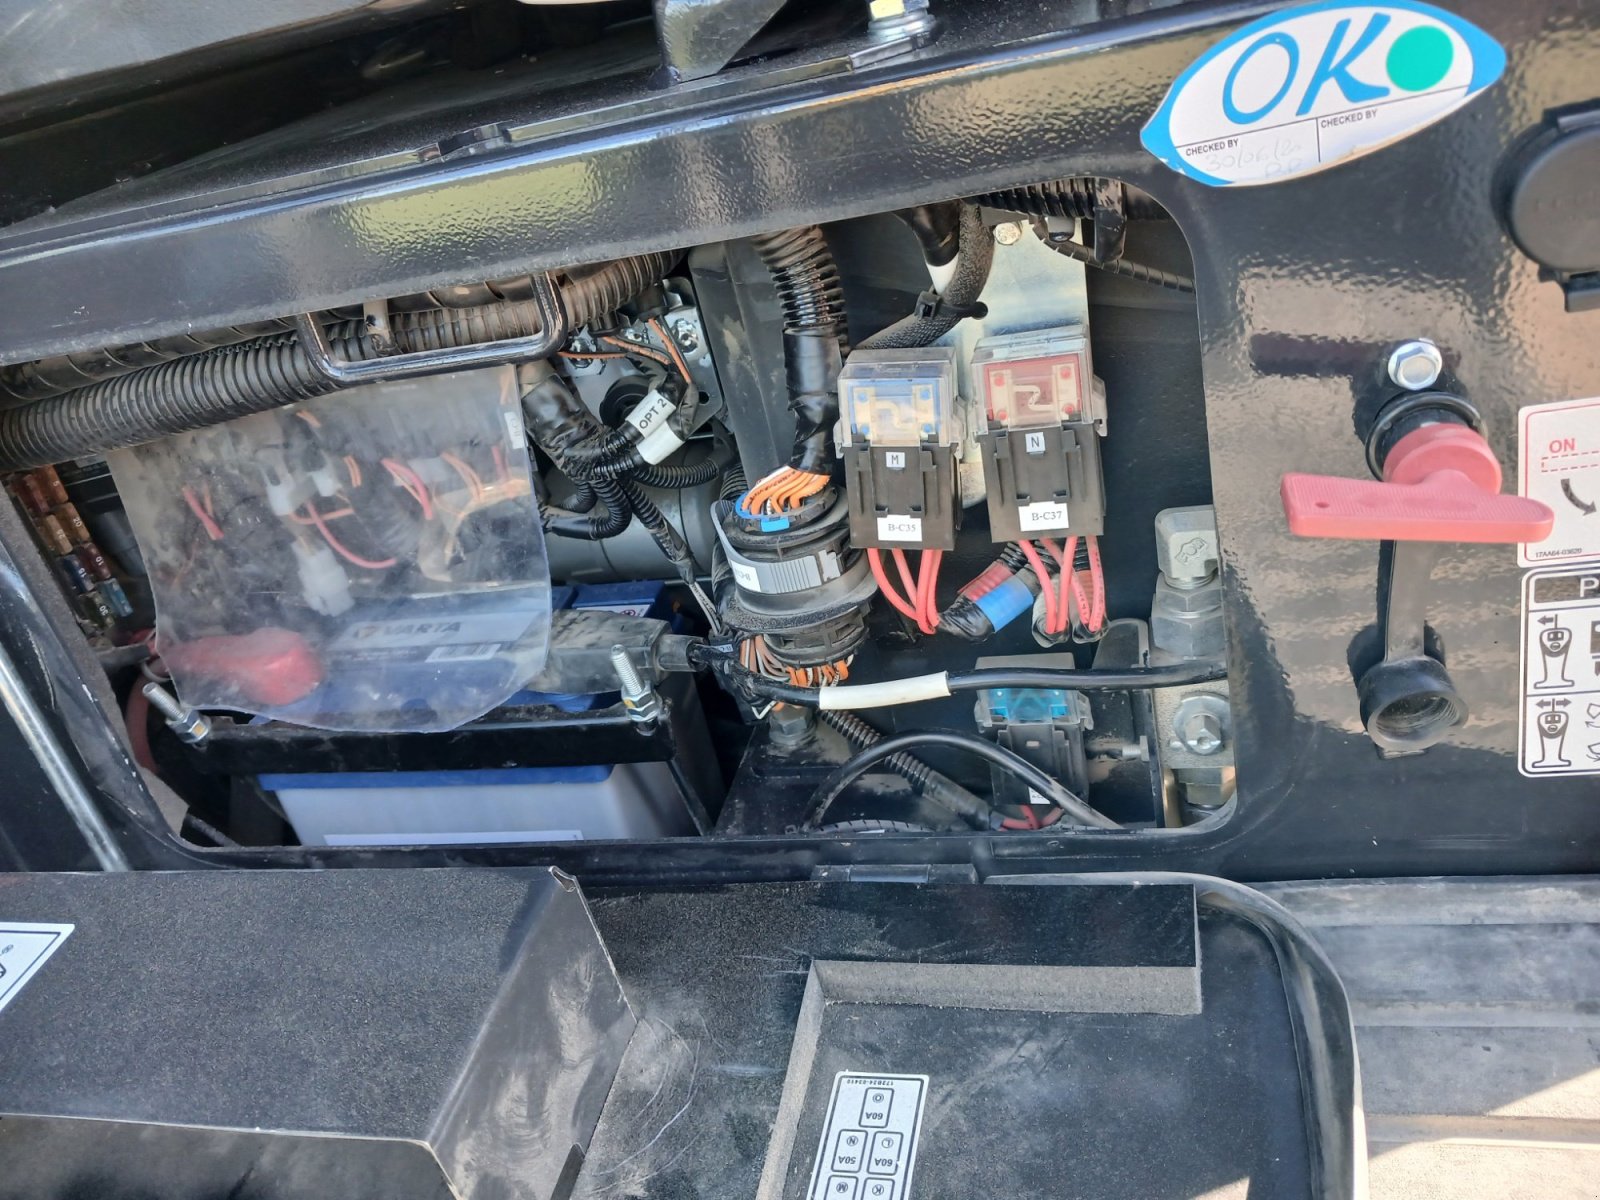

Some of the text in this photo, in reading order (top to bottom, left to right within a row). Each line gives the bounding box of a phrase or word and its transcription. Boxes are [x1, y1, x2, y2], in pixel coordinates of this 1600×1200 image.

[1222, 13, 1391, 125] OK
[1321, 109, 1378, 128] CHECKED BY
[1185, 138, 1239, 156] CHECKED BY
[639, 398, 667, 429] OPT 2
[1031, 436, 1040, 448] N
[1549, 438, 1576, 453] ON
[890, 454, 899, 465] M
[1031, 511, 1062, 521] B-C37
[887, 523, 917, 533] B-C35
[865, 1111, 884, 1120] 60A
[838, 1155, 857, 1165] 50A
[874, 1157, 893, 1167] 60A
